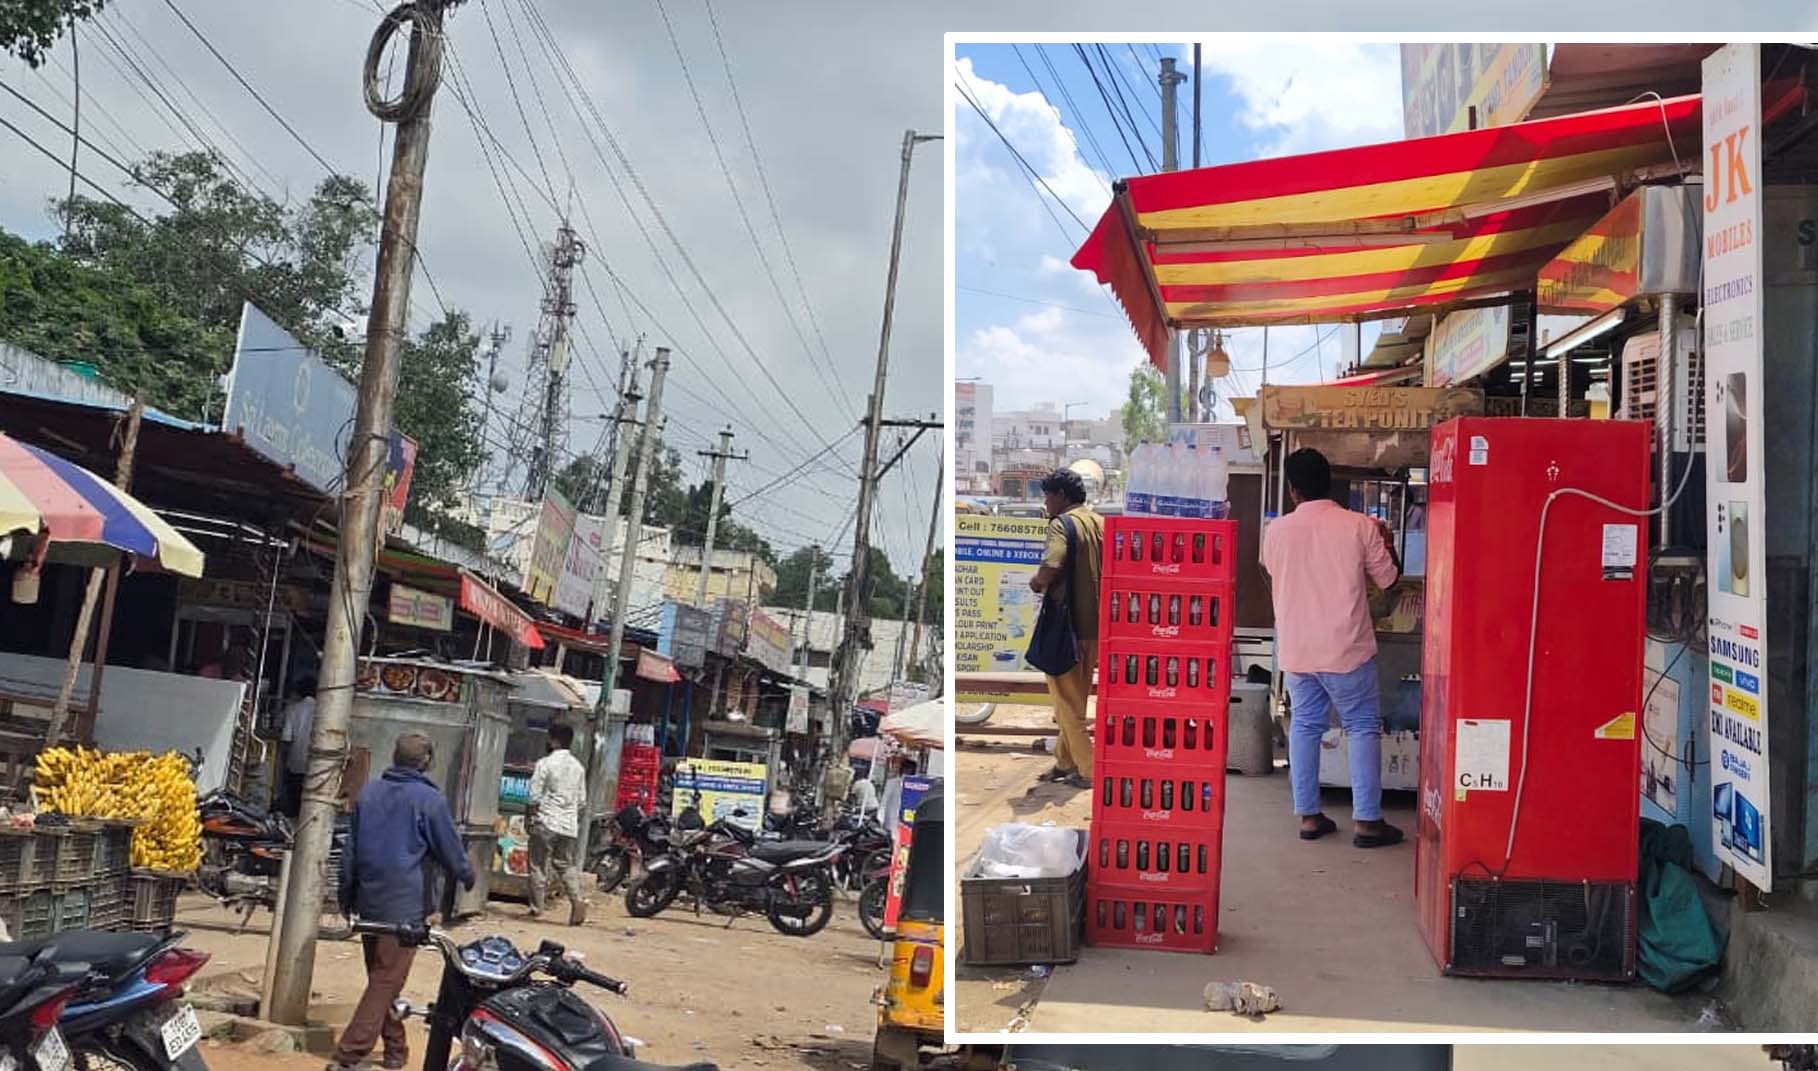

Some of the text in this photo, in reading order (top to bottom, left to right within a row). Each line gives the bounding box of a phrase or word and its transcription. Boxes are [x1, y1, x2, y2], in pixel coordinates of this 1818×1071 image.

[1706, 125, 1752, 213] JK
[1707, 218, 1752, 259] MOBILES
[1707, 274, 1752, 306] ELECTRONICS
[1319, 408, 1358, 428] TEA
[958, 522, 980, 531] Cell
[976, 548, 1004, 558] ONLINE
[1013, 550, 1040, 560] XEROX
[964, 576, 985, 586] CARD
[970, 587, 985, 597] OUT
[961, 609, 982, 618] PASS
[975, 621, 998, 630] PRINT
[960, 631, 1008, 641] APPLICATION
[956, 652, 978, 662] KISAN
[1711, 635, 1759, 668] SAMSUNG
[955, 663, 981, 672] SPORT
[1727, 694, 1757, 716] realme
[1712, 709, 1761, 756] EMI AVAILABLE
